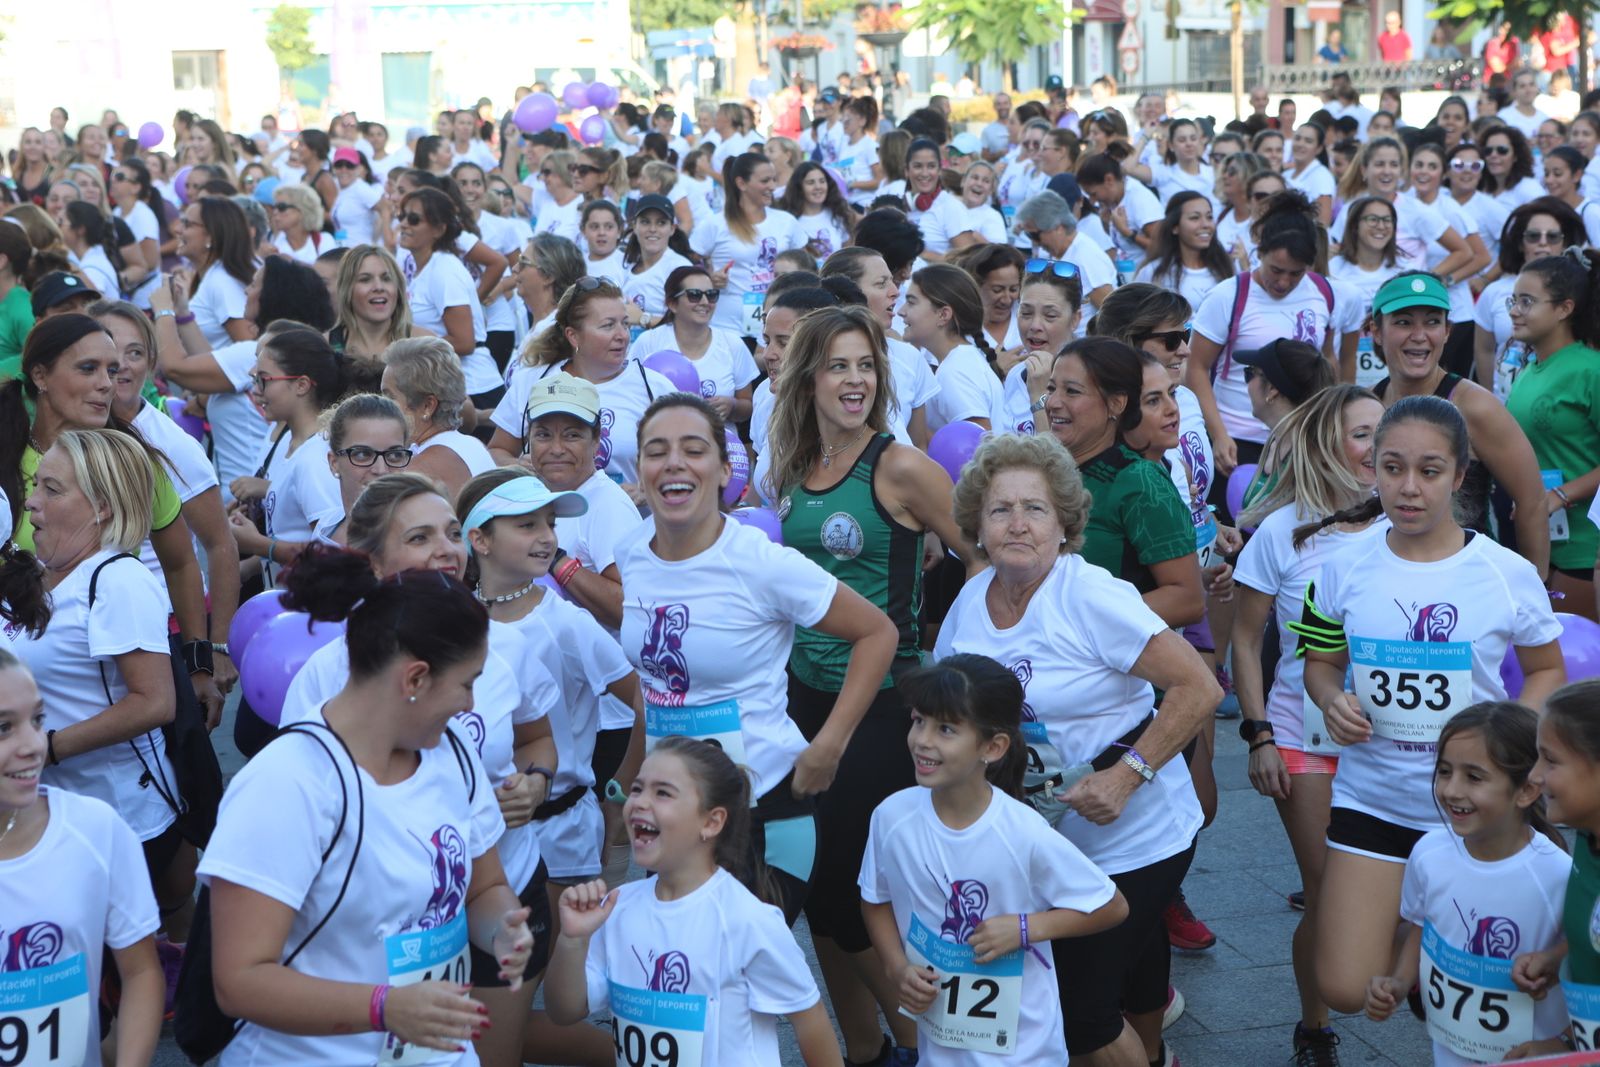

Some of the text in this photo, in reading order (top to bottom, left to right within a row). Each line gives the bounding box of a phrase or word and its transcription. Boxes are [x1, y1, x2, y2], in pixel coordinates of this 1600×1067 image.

[1385, 644, 1425, 656] Diputación
[1430, 647, 1466, 655] DEPORTES
[1397, 656, 1418, 664] Cádiz
[1369, 670, 1452, 711] 353
[695, 706, 734, 719] DEPORTES
[1407, 721, 1416, 729] DE
[1393, 729, 1425, 737] CHICLANA
[933, 942, 974, 958] Diputación
[942, 957, 965, 968] Cádiz
[43, 964, 81, 985] DEPORTES
[1428, 965, 1510, 1033] 575
[622, 1003, 644, 1017] Cádiz
[657, 1000, 700, 1012] DEPORTES
[945, 1027, 955, 1036] DE
[966, 1030, 992, 1039] MUJER
[1468, 1039, 1478, 1048] LA
[1479, 1042, 1505, 1053] MUJER
